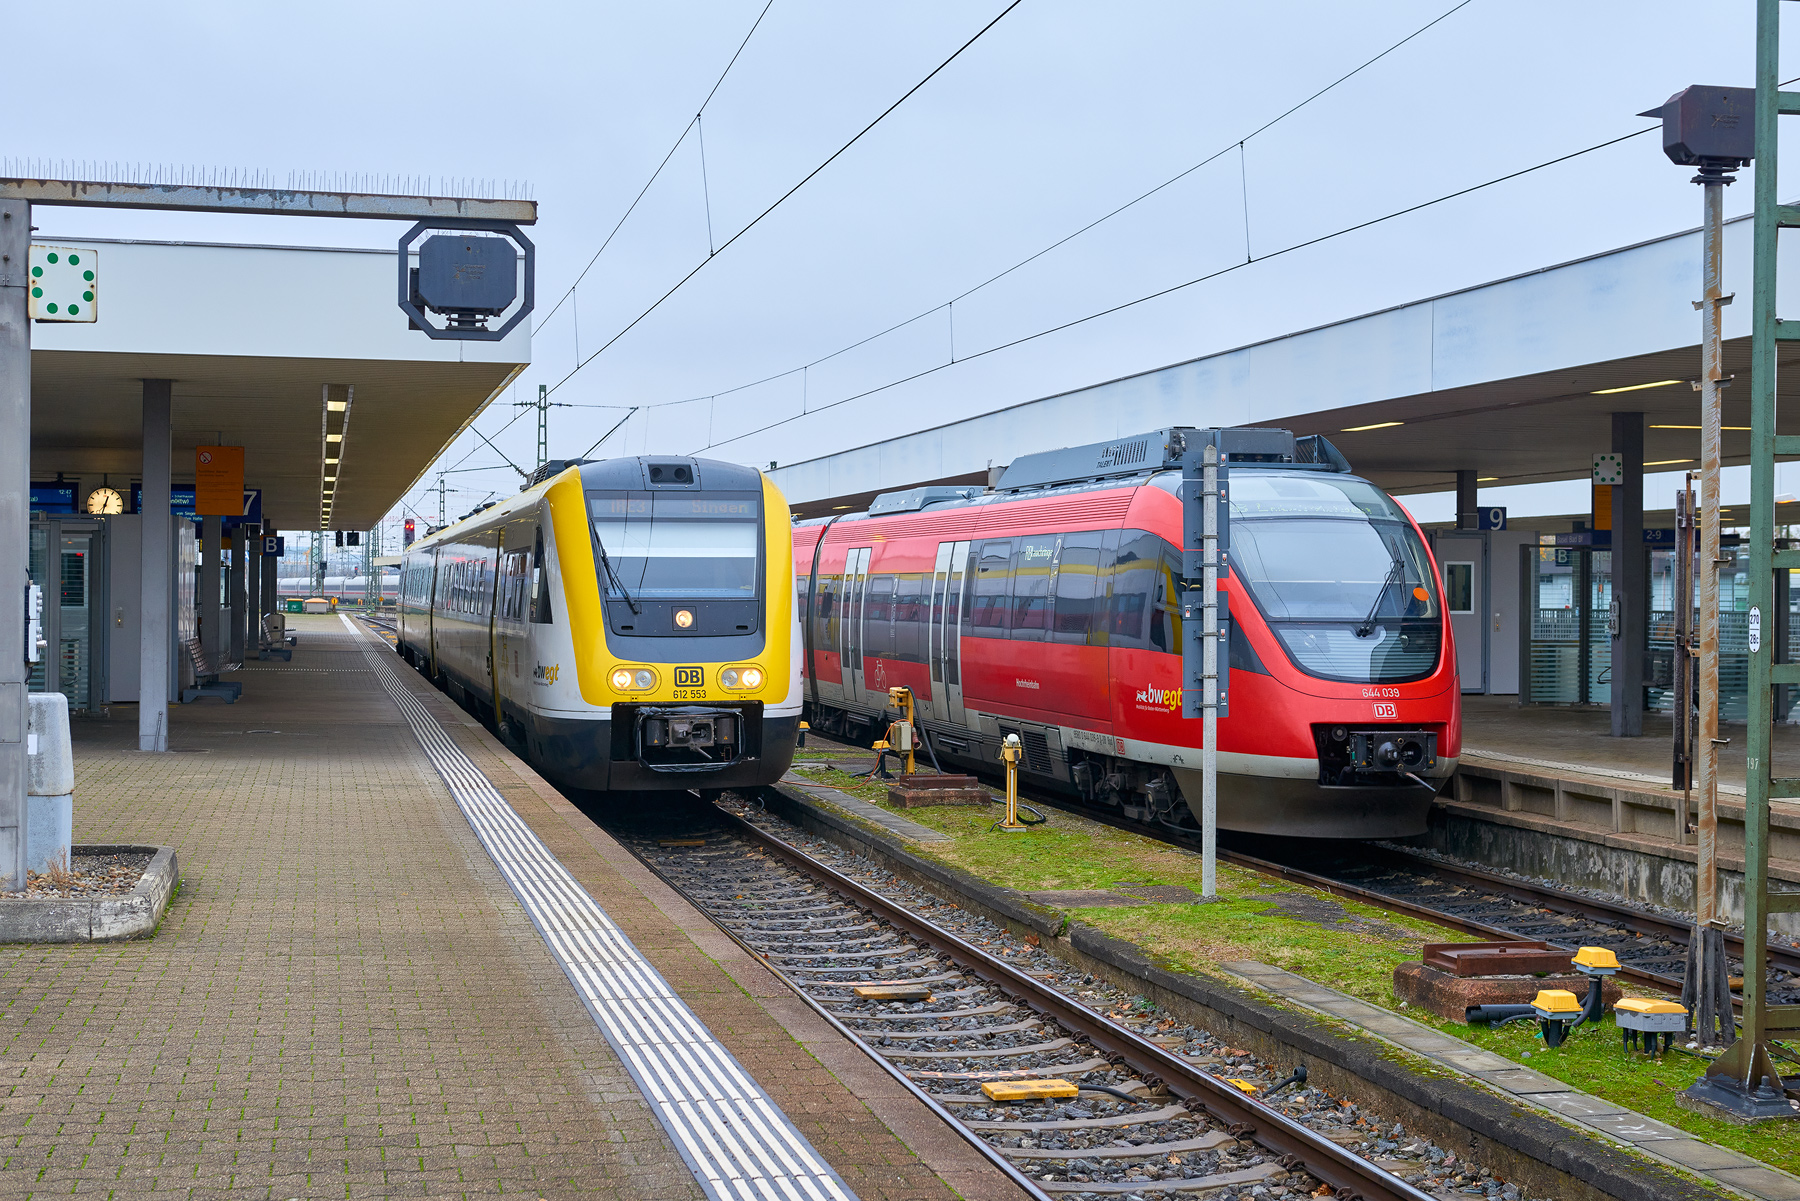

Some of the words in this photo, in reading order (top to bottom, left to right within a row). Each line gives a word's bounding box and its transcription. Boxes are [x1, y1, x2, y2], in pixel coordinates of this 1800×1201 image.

[691, 499, 748, 514] Singen
[1489, 508, 1504, 531] 9
[1646, 530, 1662, 540] 2-9
[265, 537, 277, 553] B
[1053, 538, 1061, 563] 2
[1558, 549, 1567, 563] B
[1750, 614, 1759, 625] 270
[677, 668, 702, 684] DB
[673, 689, 688, 699] 612
[690, 689, 707, 699] 553
[1148, 682, 1182, 711] bwegt
[1362, 687, 1380, 697] 644
[1382, 687, 1400, 698] 039
[1374, 703, 1396, 718] DB
[1746, 757, 1759, 770] 197
